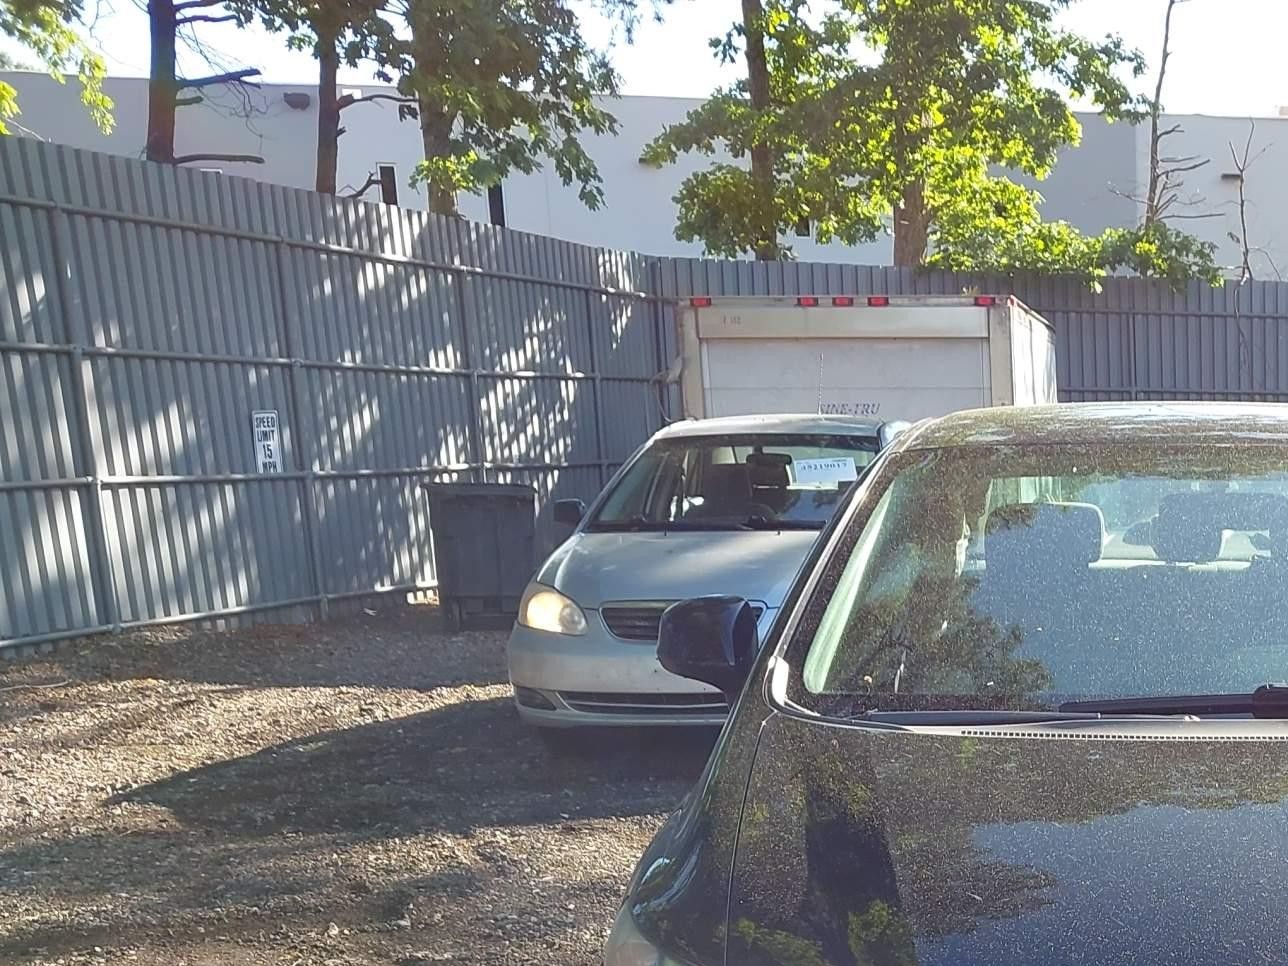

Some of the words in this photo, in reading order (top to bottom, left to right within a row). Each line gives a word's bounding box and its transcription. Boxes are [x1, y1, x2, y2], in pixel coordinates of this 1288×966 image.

[255, 416, 276, 429] SPEED
[256, 430, 275, 442] LIMIT
[262, 443, 273, 459] 15
[262, 461, 278, 473] MPH
